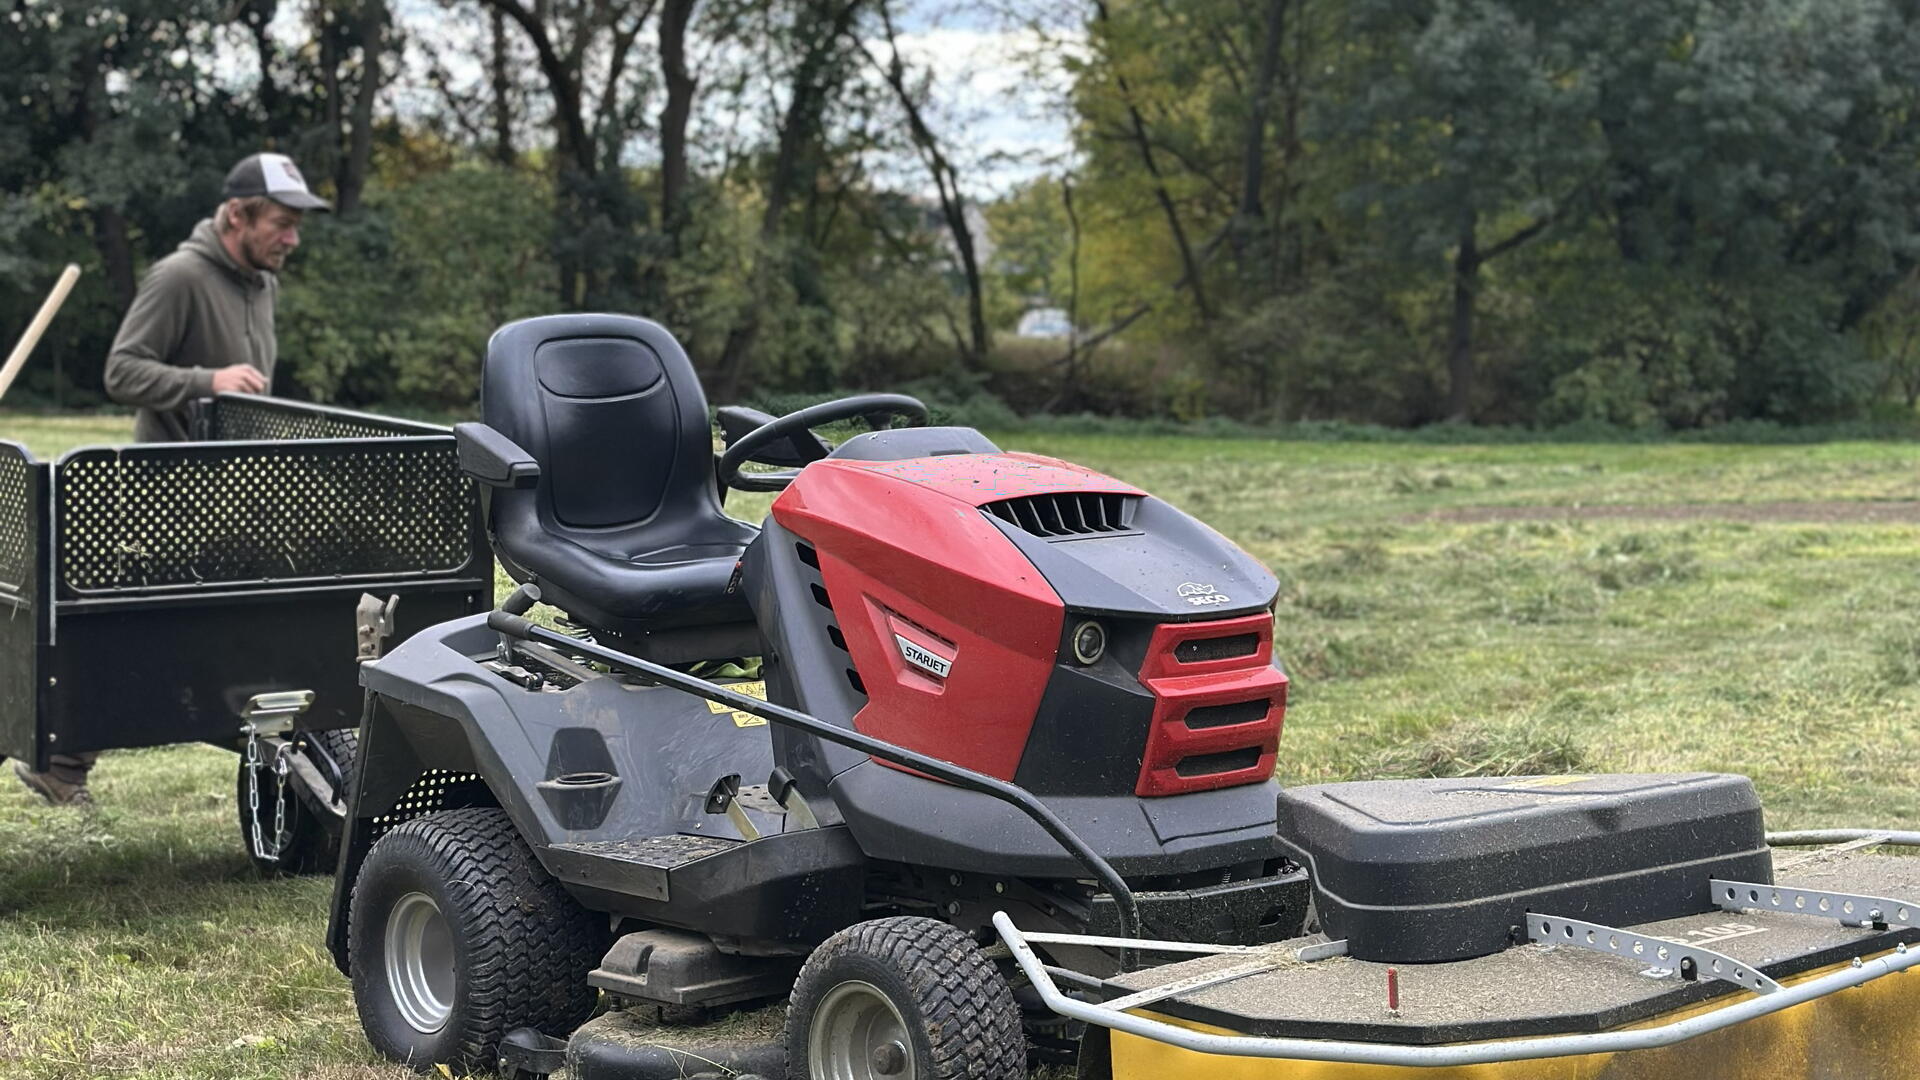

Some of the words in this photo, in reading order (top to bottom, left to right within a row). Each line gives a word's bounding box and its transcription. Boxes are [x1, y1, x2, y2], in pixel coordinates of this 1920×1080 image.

[1187, 594, 1230, 605] SECO
[905, 646, 946, 673] STARJET
[1687, 922, 1756, 938] 105
